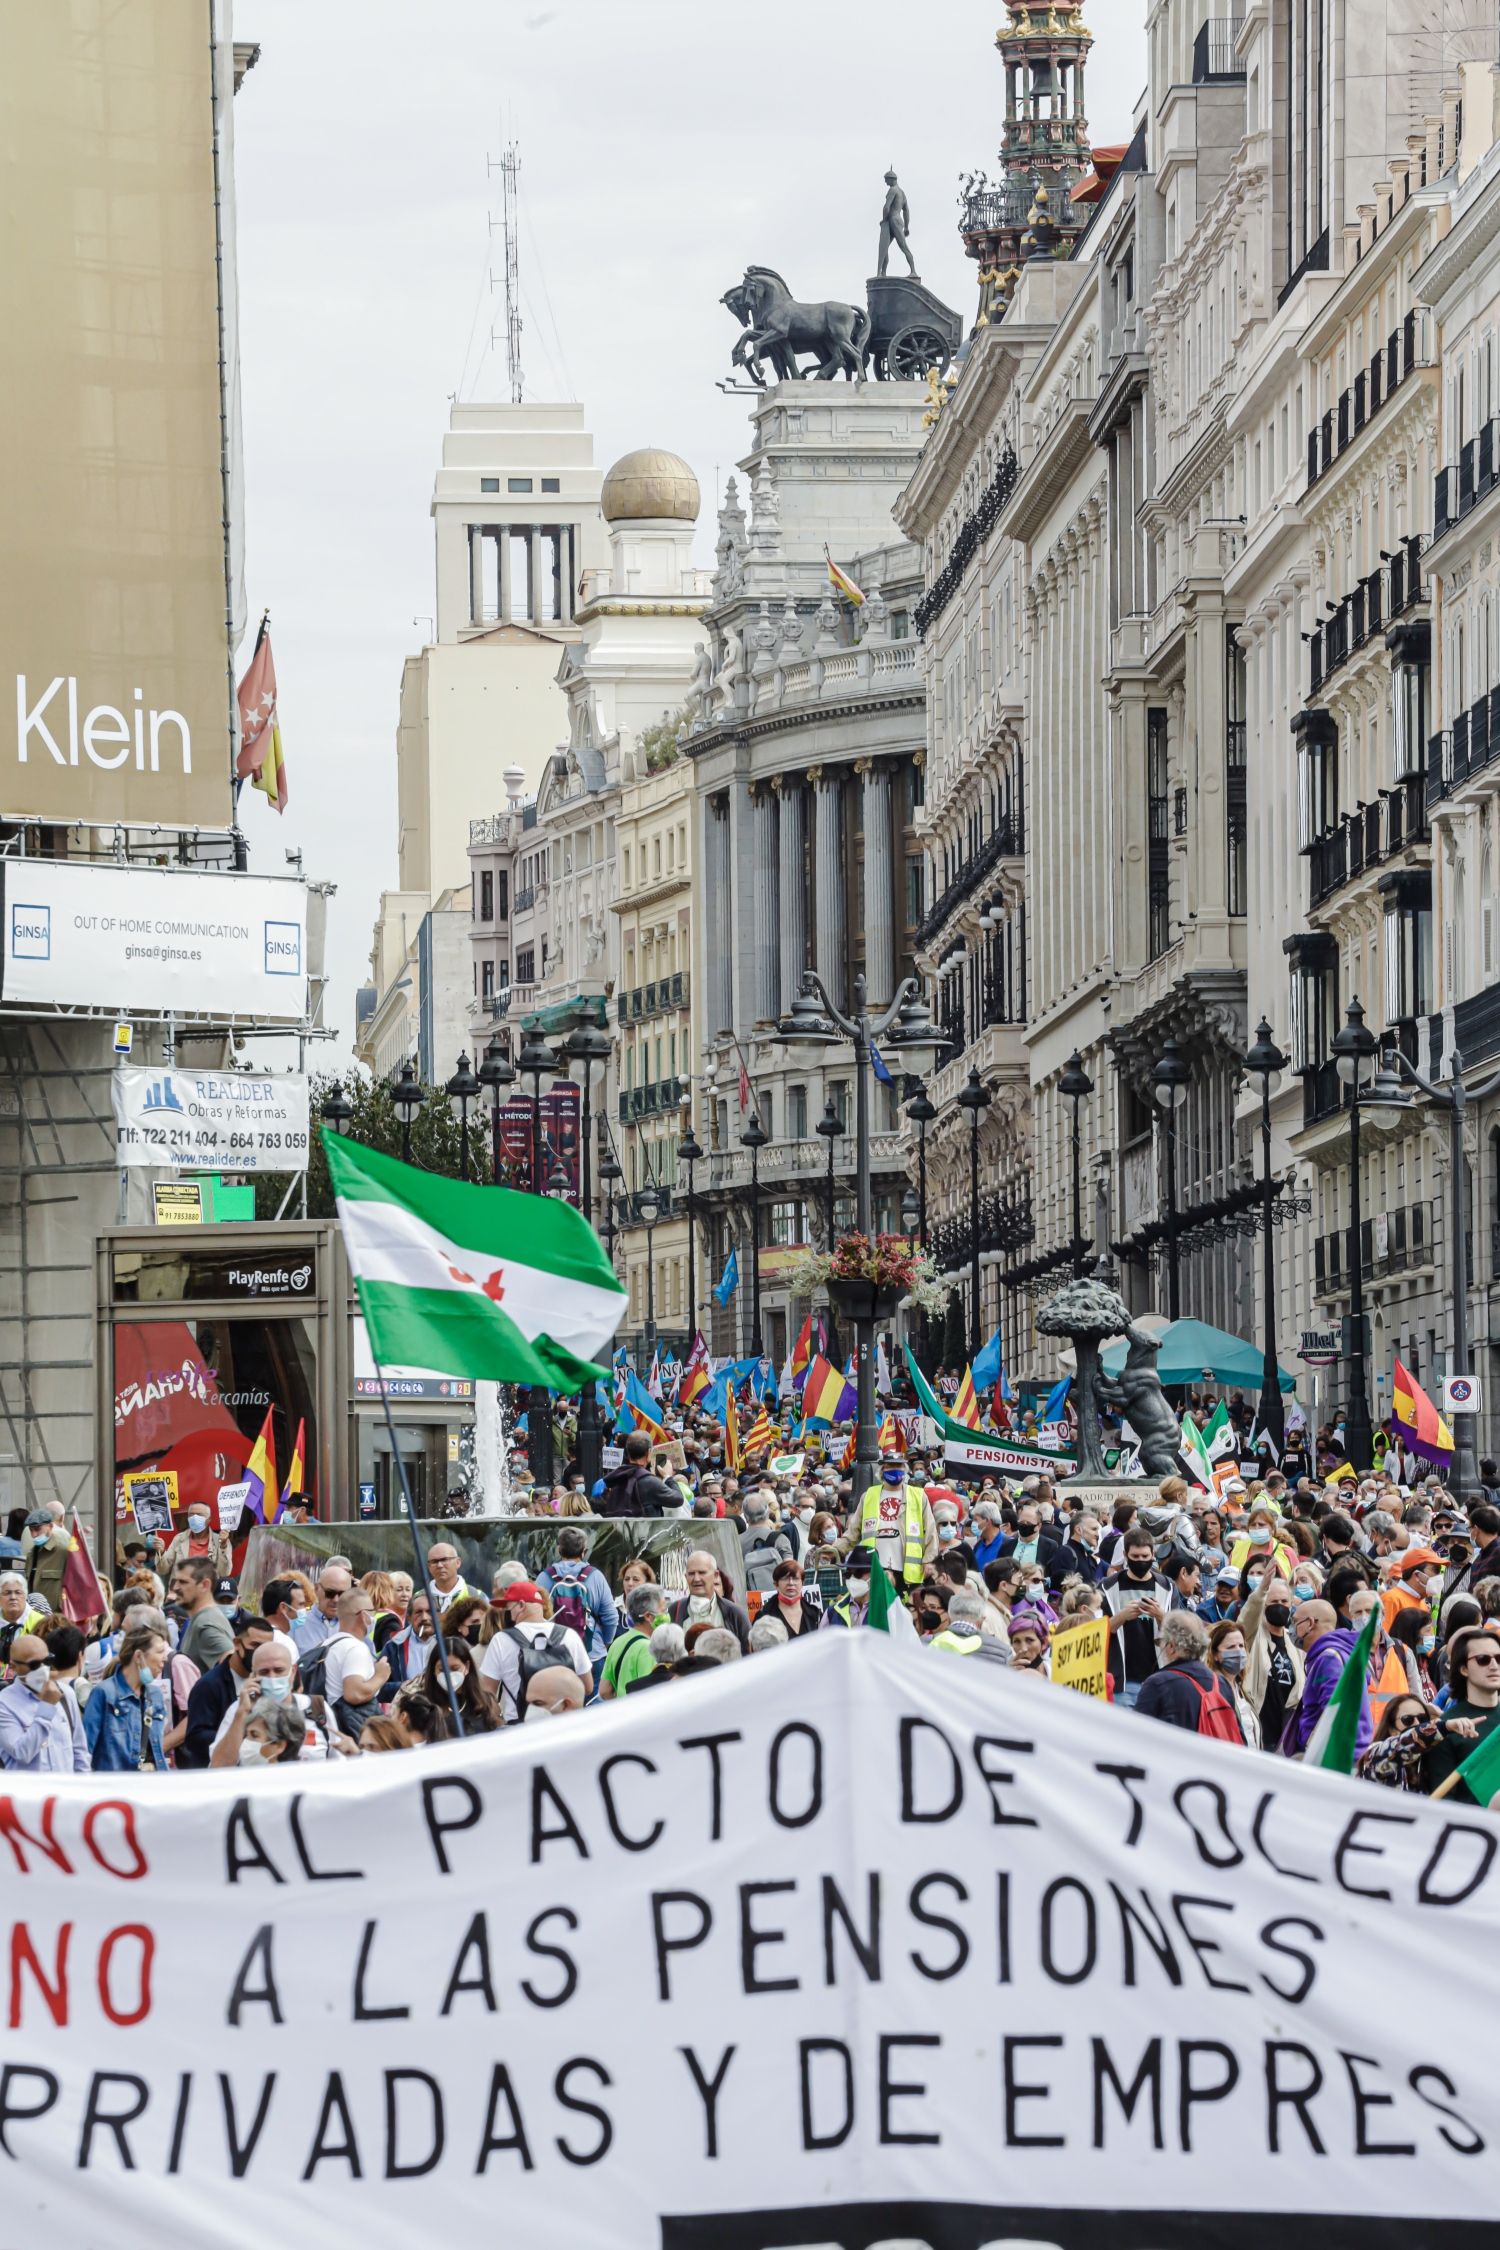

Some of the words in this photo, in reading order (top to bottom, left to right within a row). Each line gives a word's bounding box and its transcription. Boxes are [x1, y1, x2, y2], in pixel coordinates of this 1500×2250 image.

[17, 674, 192, 774] Klein
[14, 925, 49, 941] GINSA
[74, 915, 98, 930] OUT
[101, 917, 116, 932] OF
[120, 919, 152, 934] HOME
[155, 921, 249, 940] COMMUNICATION
[125, 944, 202, 962] ginsa@ginsa.es
[266, 941, 299, 956] GINSA
[196, 1081, 274, 1101] REALIDER
[188, 1103, 222, 1118] Obras
[226, 1108, 232, 1120] y
[235, 1105, 287, 1120] Reformas
[142, 1128, 166, 1144] 722
[170, 1130, 191, 1146] 211
[195, 1131, 218, 1147] 404
[230, 1132, 254, 1148] 664
[259, 1133, 282, 1148] 763
[285, 1134, 307, 1149] 059
[170, 1152, 257, 1166] www.realider.es
[228, 1269, 289, 1288] PlayRenfe
[662, 1364, 682, 1378] NO
[942, 1378, 958, 1392] NO
[202, 1387, 270, 1406] Cercanías
[966, 1448, 1055, 1468] PENSIONISTA
[1074, 1493, 1114, 1501] MADRID
[1058, 1642, 1073, 1668] SOY
[1076, 1632, 1102, 1660] VIEJO,
[0, 1795, 150, 1880] NO
[225, 1792, 365, 1885] AL
[421, 1719, 823, 1875] PACTO
[899, 1716, 1039, 1827] DE
[8, 1920, 156, 2029] NO
[227, 1923, 286, 2027] A
[352, 1904, 580, 2022] LAS
[650, 1869, 1326, 2004] PENSIONES
[0, 2055, 615, 2182] PRIVADAS
[677, 2043, 737, 2160] Y
[799, 2032, 943, 2153] DE
[1001, 2032, 1486, 2157] EMPRES
